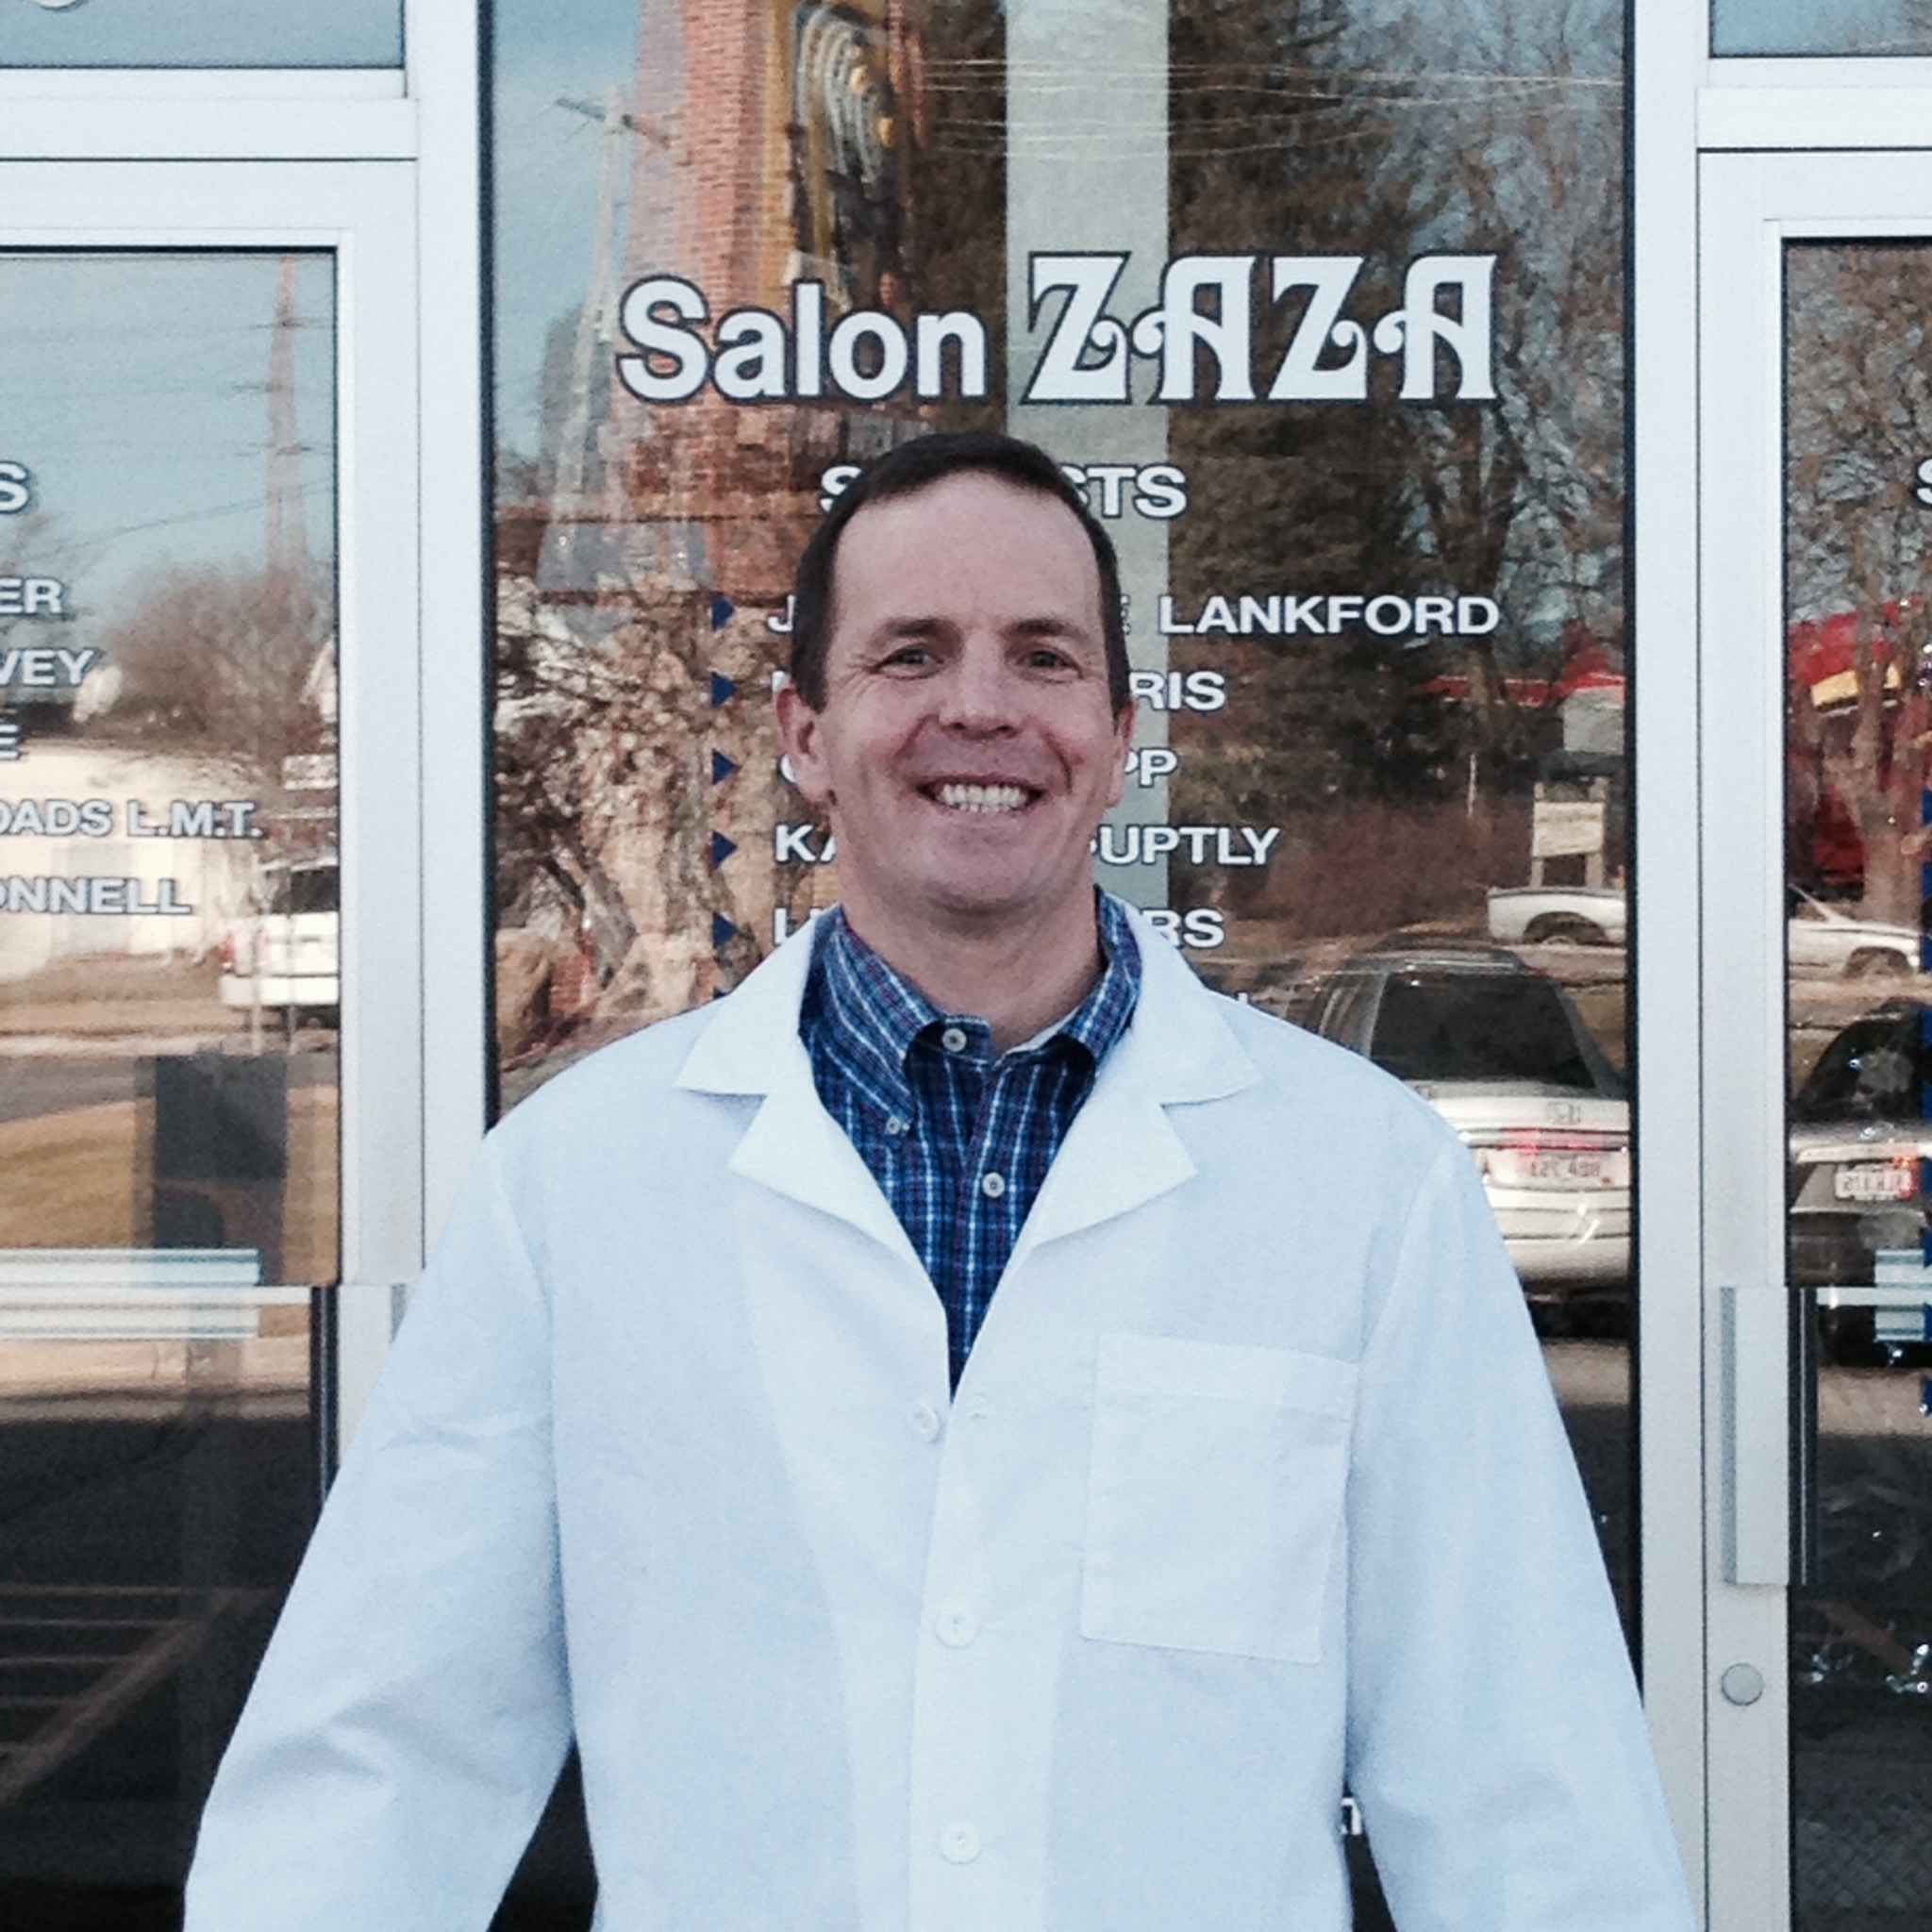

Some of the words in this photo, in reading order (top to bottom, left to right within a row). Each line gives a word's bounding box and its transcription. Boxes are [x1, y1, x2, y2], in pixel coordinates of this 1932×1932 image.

[618, 275, 989, 402] Salon
[1024, 251, 1500, 403] ZAZA
[1159, 595, 1500, 634] LANKFORD
[127, 801, 265, 838] L.M.T.
